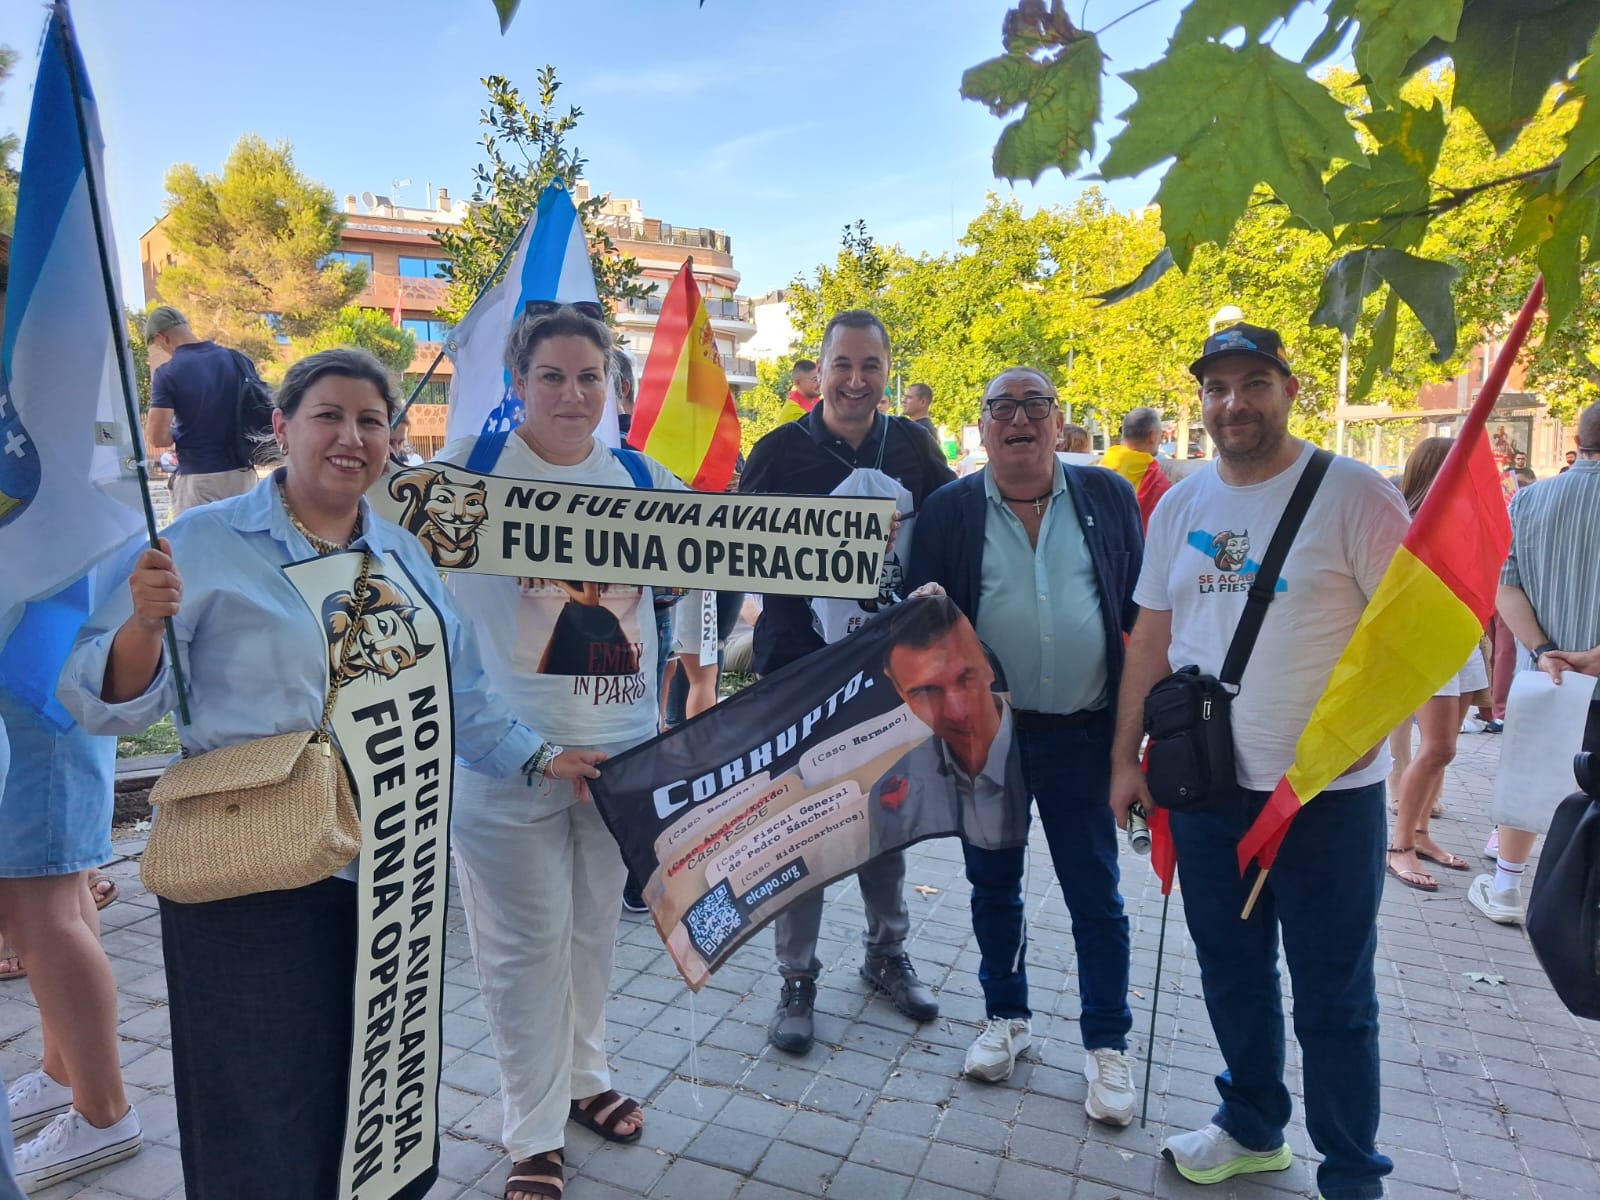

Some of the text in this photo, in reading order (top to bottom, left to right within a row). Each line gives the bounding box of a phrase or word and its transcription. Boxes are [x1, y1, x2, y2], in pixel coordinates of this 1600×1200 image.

[505, 486, 889, 541] NO FUE UNA AVALANCHA.
[502, 520, 879, 586] FUE UNA OPERACIÓN.
[1199, 572, 1255, 584] SE ACAB
[1200, 582, 1254, 593] LA FIEST
[848, 617, 861, 625] SE
[588, 642, 644, 674] EMILY
[573, 672, 646, 705] IN PARIS
[723, 805, 769, 842] PSOE
[753, 814, 794, 843] Fiscal
[799, 787, 849, 816] General
[728, 860, 742, 873] de
[747, 834, 781, 859] Pedro
[745, 864, 801, 905] elcapo.org
[351, 698, 406, 1200] FUE UNA OPERACIÓN.
[393, 685, 440, 1174] NO FUE UNA AVALANCHA.
